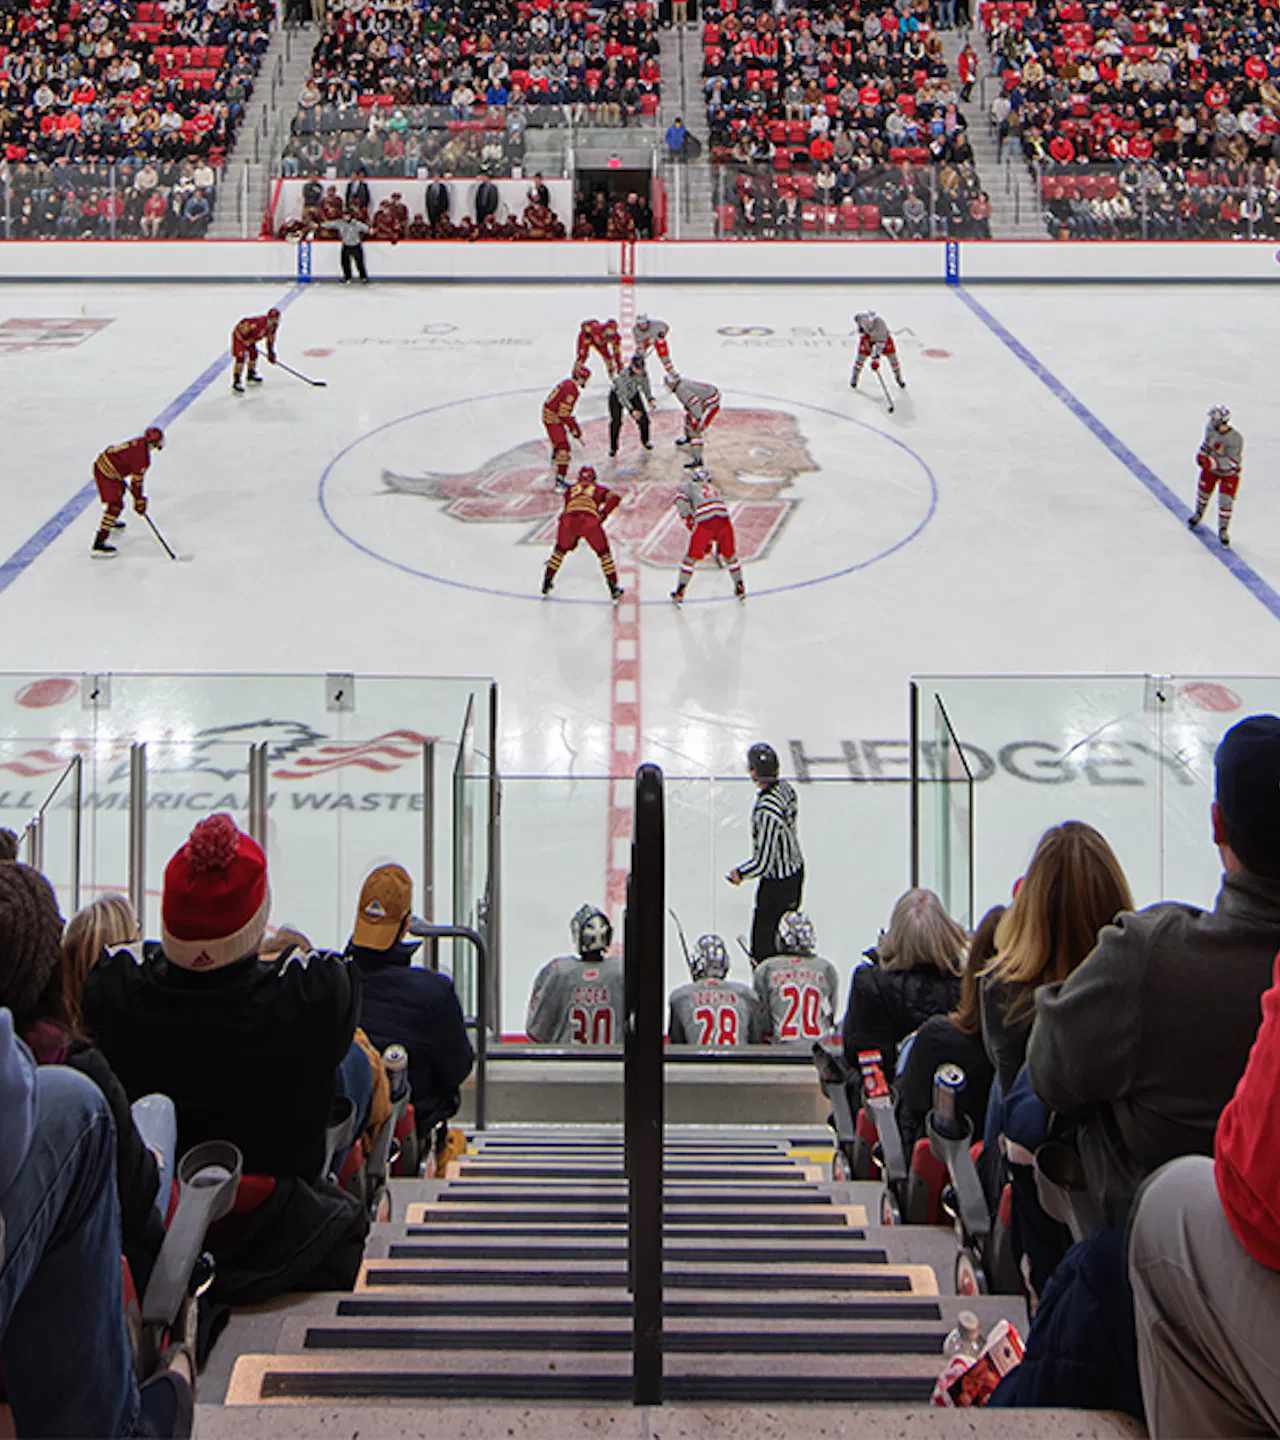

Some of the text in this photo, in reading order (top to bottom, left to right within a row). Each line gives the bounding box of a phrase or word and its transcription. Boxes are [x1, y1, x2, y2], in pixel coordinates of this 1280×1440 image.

[292, 790, 428, 813] WASTE
[571, 1006, 613, 1045] 30
[695, 1006, 738, 1045] 28
[780, 986, 822, 1039] 20
